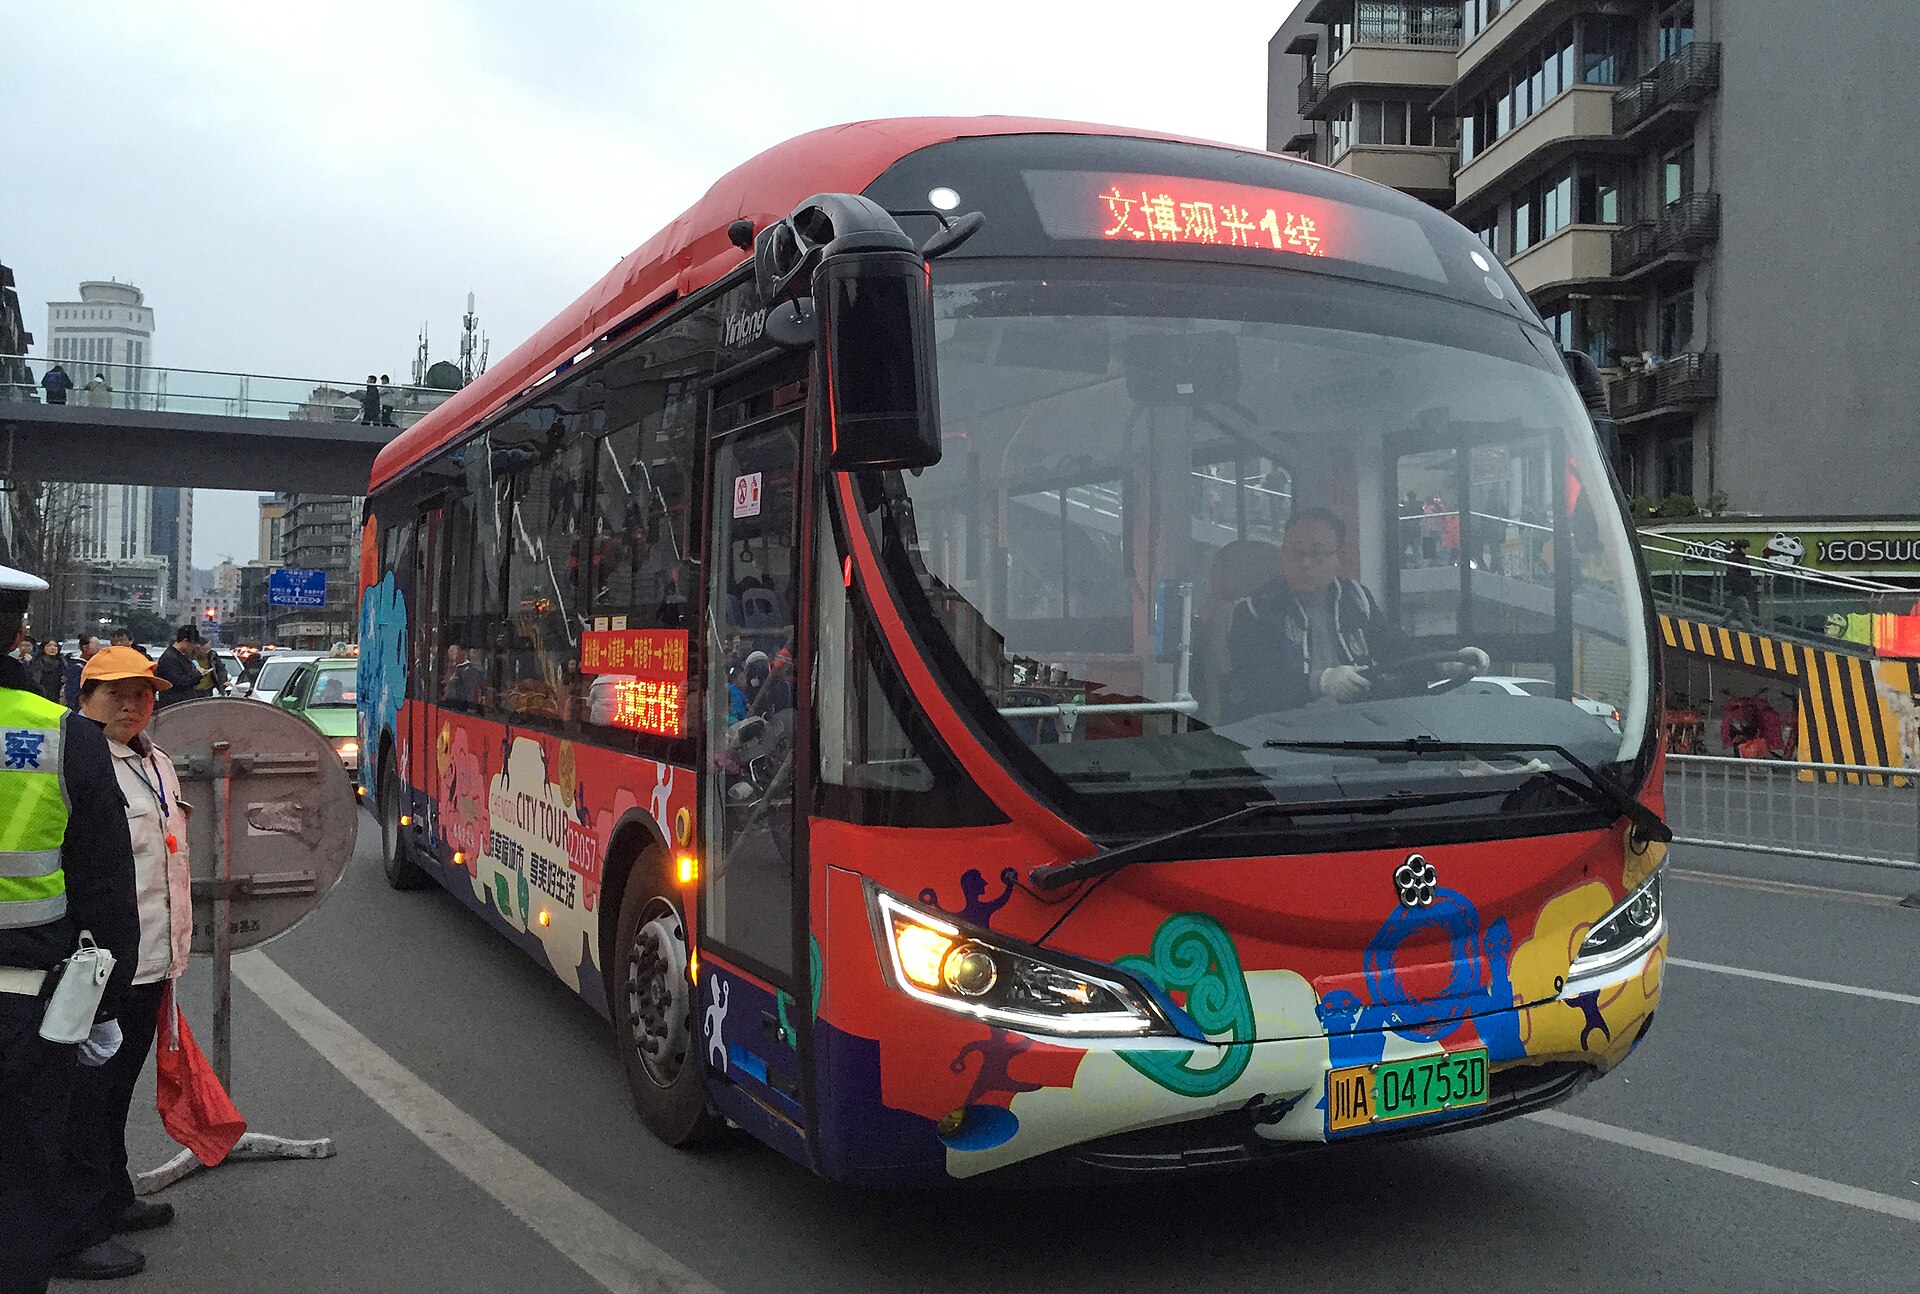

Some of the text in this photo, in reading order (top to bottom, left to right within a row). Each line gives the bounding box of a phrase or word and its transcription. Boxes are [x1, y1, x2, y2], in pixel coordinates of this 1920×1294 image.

[1099, 187, 1325, 257] 文博观光1线
[724, 308, 766, 347] Yinlong
[4, 730, 45, 768] 察
[516, 791, 537, 835] CITY
[539, 800, 569, 853] TOUR
[567, 828, 597, 873] 22057
[1335, 1057, 1485, 1121] 川A 04753D
